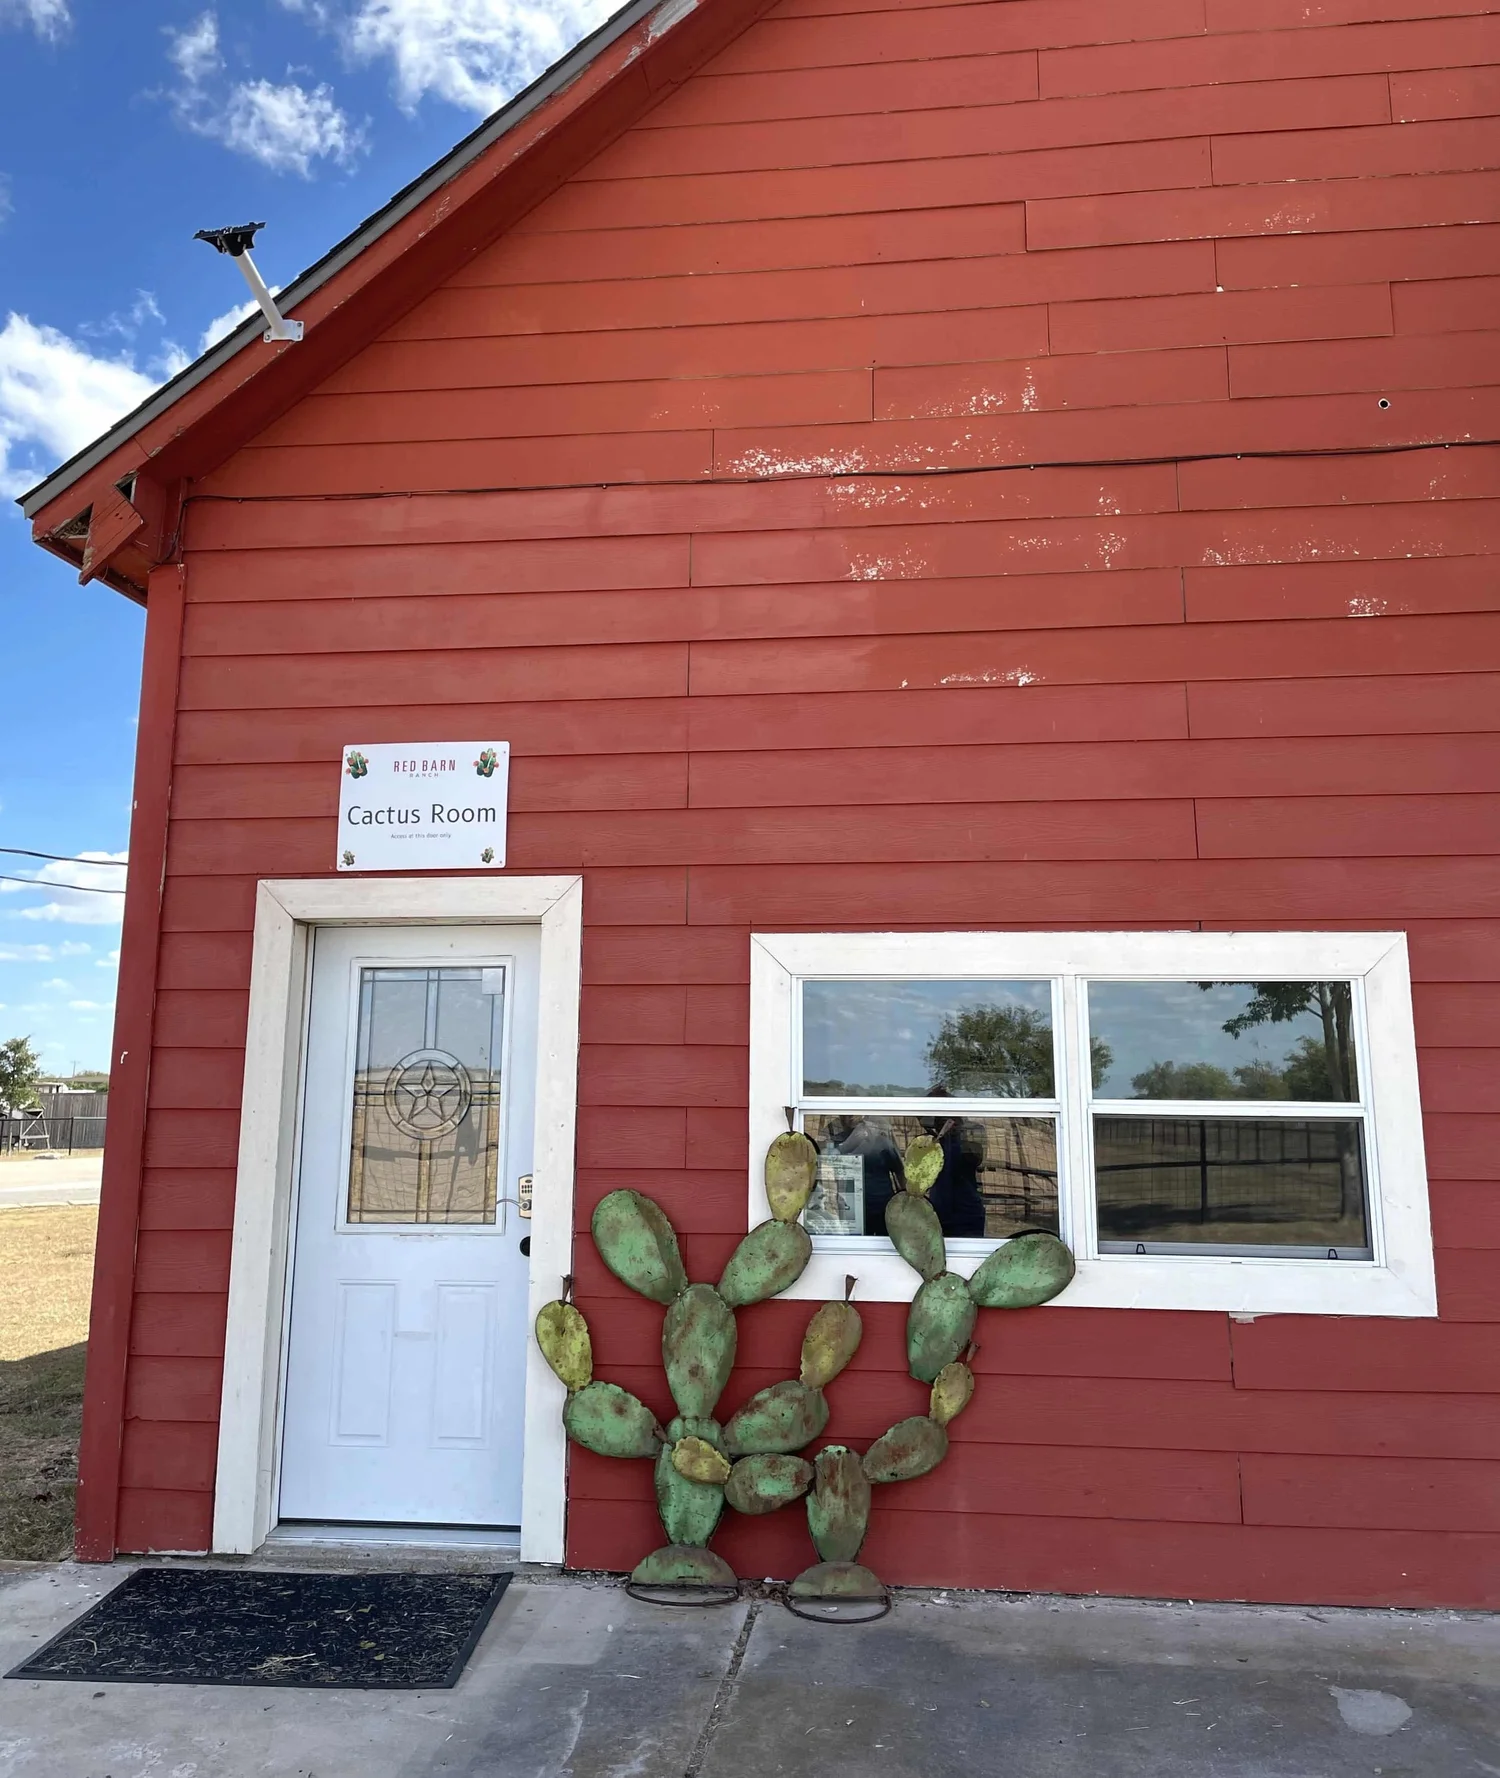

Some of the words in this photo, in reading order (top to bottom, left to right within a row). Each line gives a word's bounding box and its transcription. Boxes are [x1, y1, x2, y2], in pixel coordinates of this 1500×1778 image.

[393, 760, 416, 773] RED
[422, 759, 456, 772] BARN
[347, 805, 421, 825] Cactus
[431, 803, 496, 823] Room
